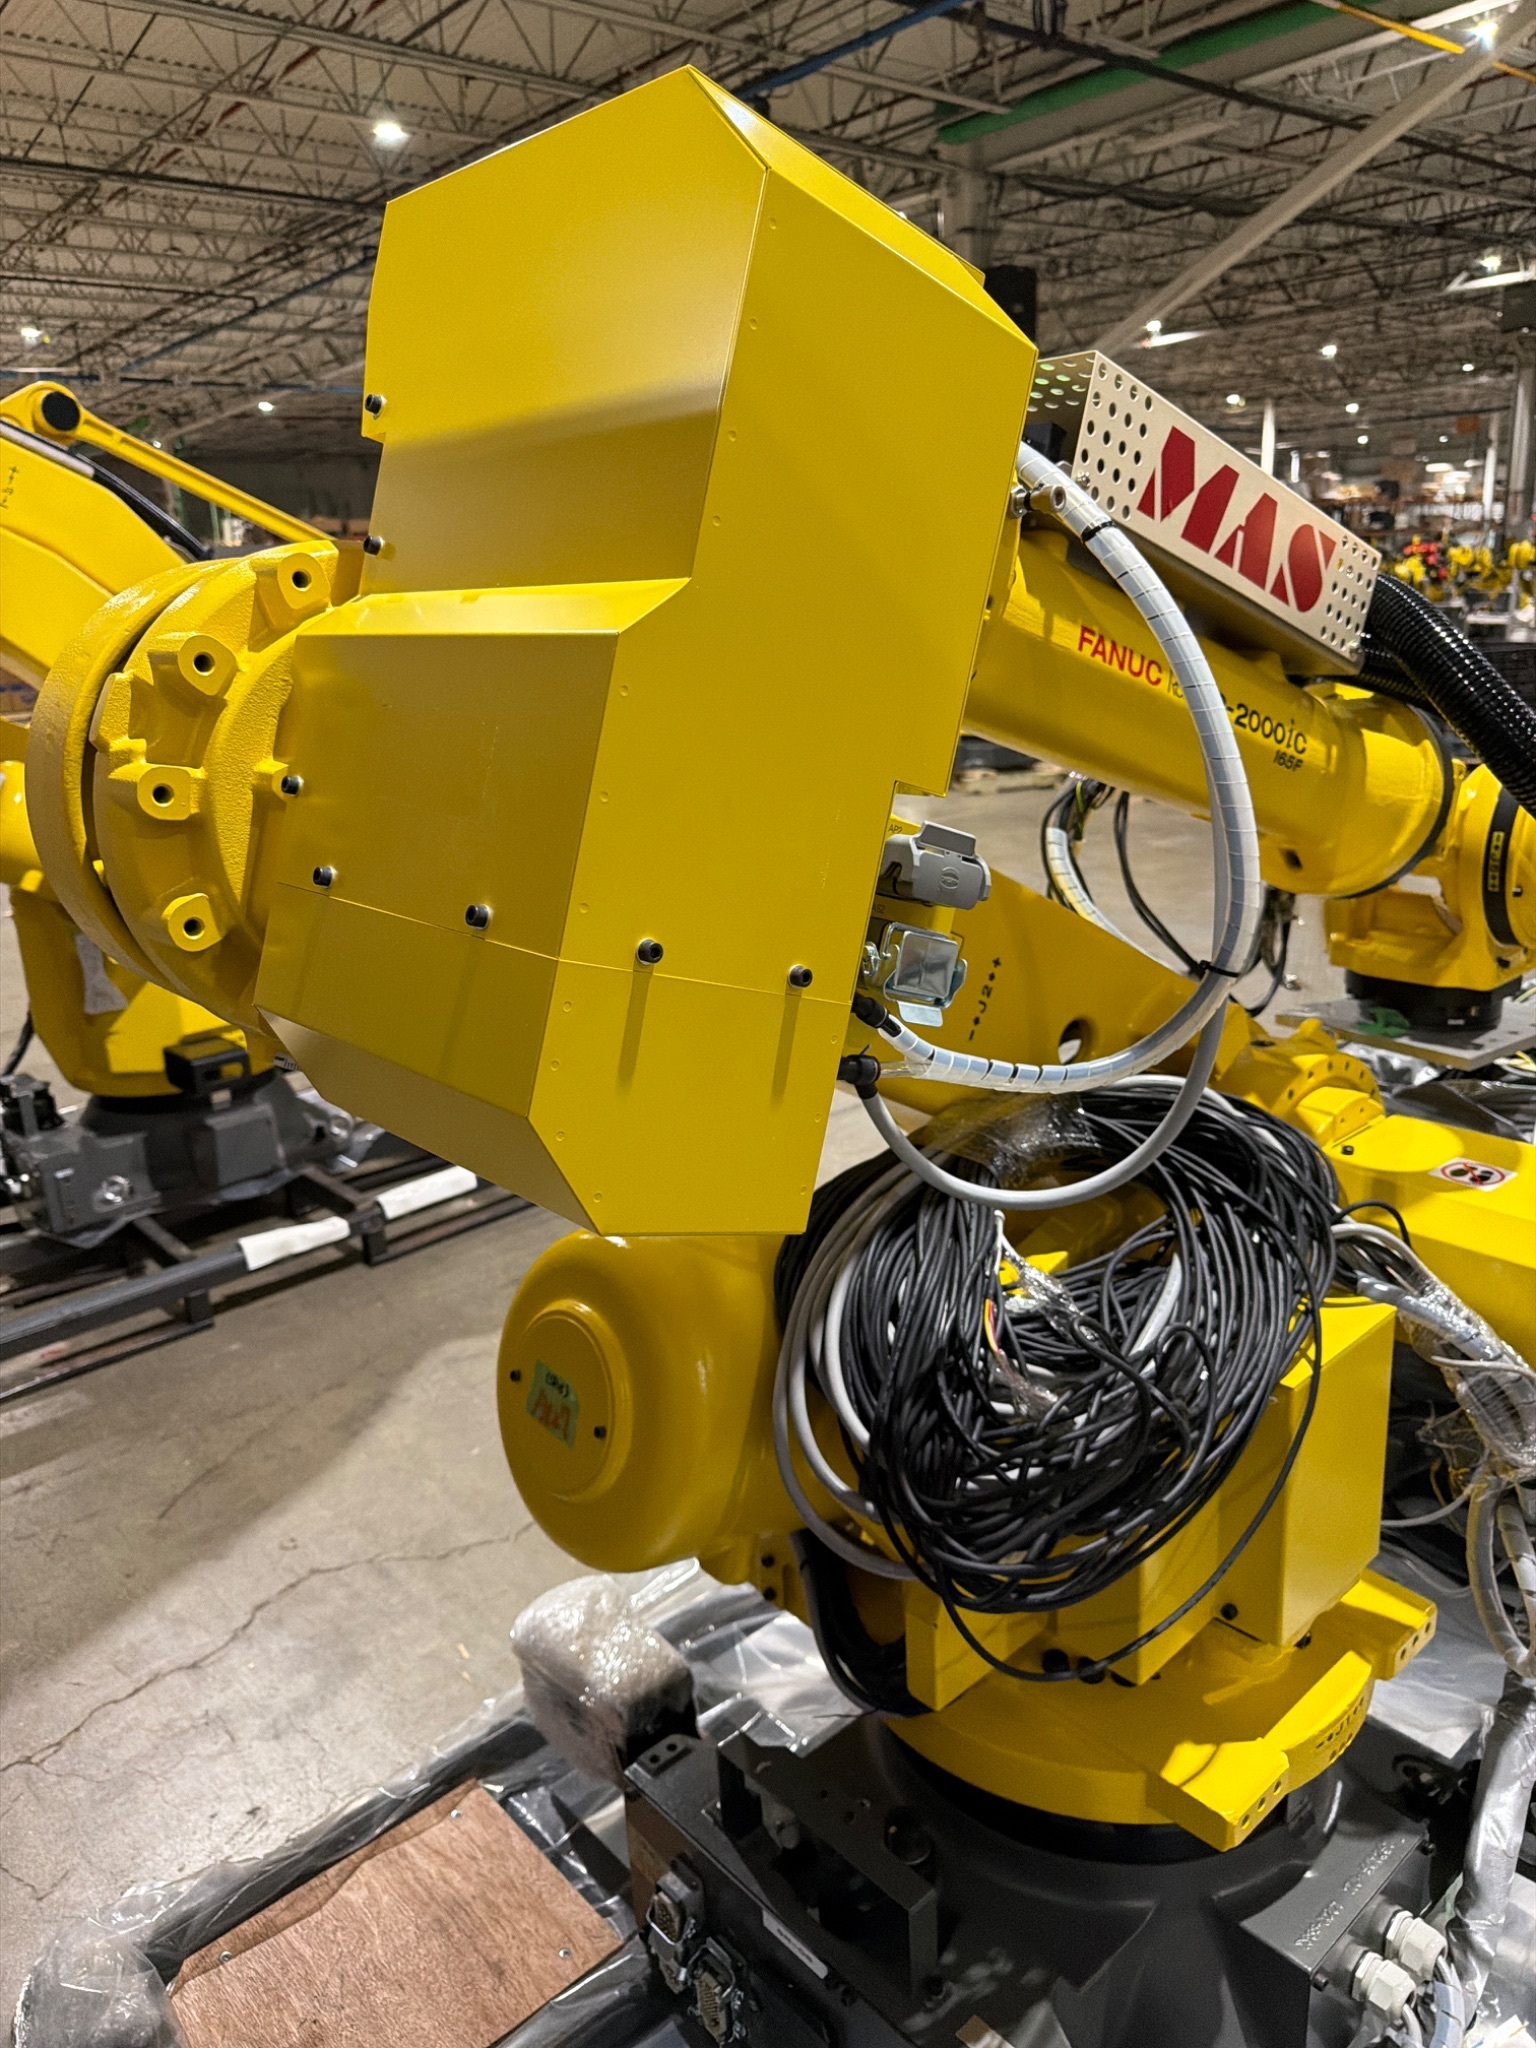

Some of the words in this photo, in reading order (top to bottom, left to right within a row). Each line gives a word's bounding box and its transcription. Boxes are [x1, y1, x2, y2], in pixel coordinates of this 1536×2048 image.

[1137, 425, 1337, 613] MAS
[1078, 625, 1163, 686] FANUC
[1220, 692, 1307, 754] -2000iC
[1273, 749, 1304, 772] 165F
